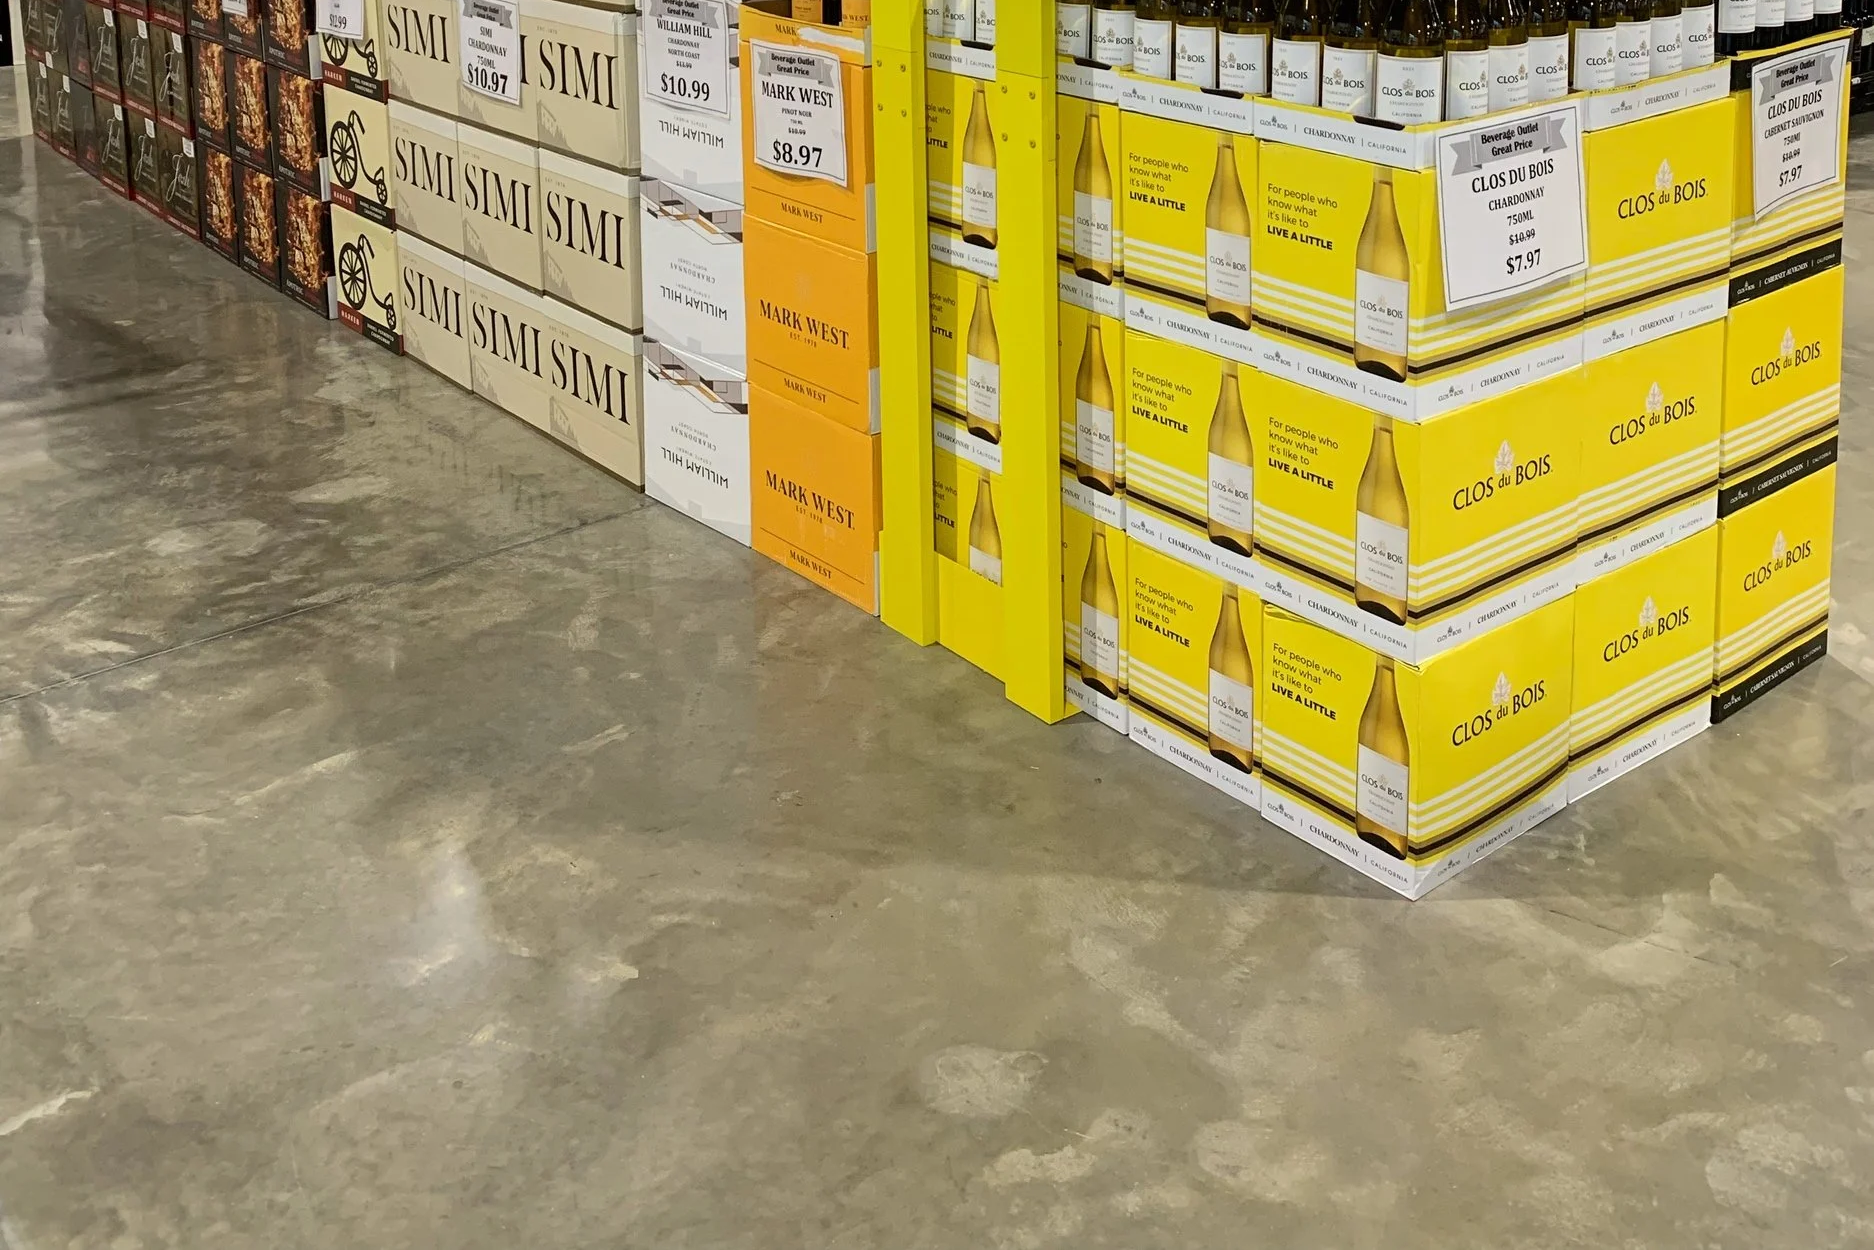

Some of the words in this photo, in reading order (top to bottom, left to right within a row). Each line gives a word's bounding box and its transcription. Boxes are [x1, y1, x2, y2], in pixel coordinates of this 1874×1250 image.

[667, 8, 681, 17] Great
[682, 10, 694, 18] Price
[685, 0, 699, 10] Outlet
[387, 4, 450, 64] SIMI
[480, 26, 492, 38] SIMI
[657, 18, 691, 35] WILLIAM
[693, 25, 712, 39] HILL
[775, 24, 797, 36] MARK
[468, 37, 507, 57] CHARDONNAY
[667, 37, 700, 49] CHARDONNAY
[667, 48, 684, 58] NORTH
[685, 51, 700, 60] COAST
[477, 55, 495, 69] 750ML
[771, 53, 796, 65] Beverage
[797, 57, 815, 66] Outlet
[777, 65, 792, 74] Great
[794, 67, 809, 76] Price
[1776, 65, 1798, 78] Beverage
[1800, 58, 1816, 70] Outlet
[467, 64, 508, 94] $10.97
[540, 38, 619, 110] SIMI
[661, 72, 710, 101] $10.99
[1781, 78, 1794, 88] Great
[1795, 74, 1809, 84] Price
[762, 81, 795, 101] MARK
[799, 87, 833, 108] WEST
[1382, 85, 1402, 98] CLOS
[1415, 88, 1435, 99] BOIS
[1768, 100, 1787, 120] CLOS
[1788, 97, 1800, 113] DU
[1802, 89, 1822, 108] BOIS
[782, 108, 797, 116] PINOT
[799, 109, 812, 118] NOIR
[1765, 120, 1791, 139] CABERNET
[1791, 109, 1824, 130] SAUVIGNON
[659, 120, 680, 136] HILL
[683, 127, 724, 148] WILLIAM
[1303, 126, 1356, 145] CHARDONNAY
[1367, 141, 1407, 155] CALIFORNIA
[1481, 130, 1516, 145] Beverage
[1516, 122, 1539, 136] Outlet
[773, 138, 823, 168] $8.97
[1491, 145, 1512, 157] Great
[1514, 140, 1533, 152] Price
[395, 137, 456, 203] SIMI
[1471, 172, 1506, 193] CLOS
[1509, 167, 1526, 184] DU
[1529, 158, 1554, 180] BOIS
[1779, 165, 1802, 188] $7.97
[464, 162, 534, 235] SIMI
[1268, 183, 1282, 195] For
[1284, 188, 1315, 205] people
[1317, 196, 1338, 209] who
[1268, 196, 1290, 211] know
[1293, 202, 1318, 218] what
[1488, 186, 1545, 211] CHARDONNAY
[1617, 191, 1655, 220] CLOS
[1658, 190, 1671, 205] du
[781, 201, 801, 217] MARK
[803, 207, 824, 224] WEST
[1282, 211, 1297, 226] like
[1299, 217, 1309, 229] to
[1507, 209, 1534, 226] 750ML
[547, 190, 625, 271] SIMI
[1267, 225, 1288, 240] LIVE
[1290, 232, 1299, 242] A
[1300, 232, 1333, 251] LITTLE
[1509, 228, 1536, 246] $10.99
[1506, 248, 1542, 276] $7.97
[403, 265, 464, 339] SIMI
[660, 285, 683, 305] HILL
[685, 296, 728, 322] WILLIAM
[759, 299, 801, 326] MARK
[472, 301, 543, 379] SIMI
[551, 339, 630, 426] SIMI
[1751, 358, 1780, 386] CLOS
[1783, 355, 1792, 369] du
[783, 377, 805, 394] MARK
[806, 386, 827, 404] WEST
[1609, 415, 1646, 446] CLOS
[1649, 411, 1660, 427] du
[661, 446, 683, 468] HILL
[686, 461, 729, 489] WILLIAM
[765, 469, 807, 502] MARK
[1452, 480, 1494, 511] CLOS
[1498, 472, 1511, 489] du
